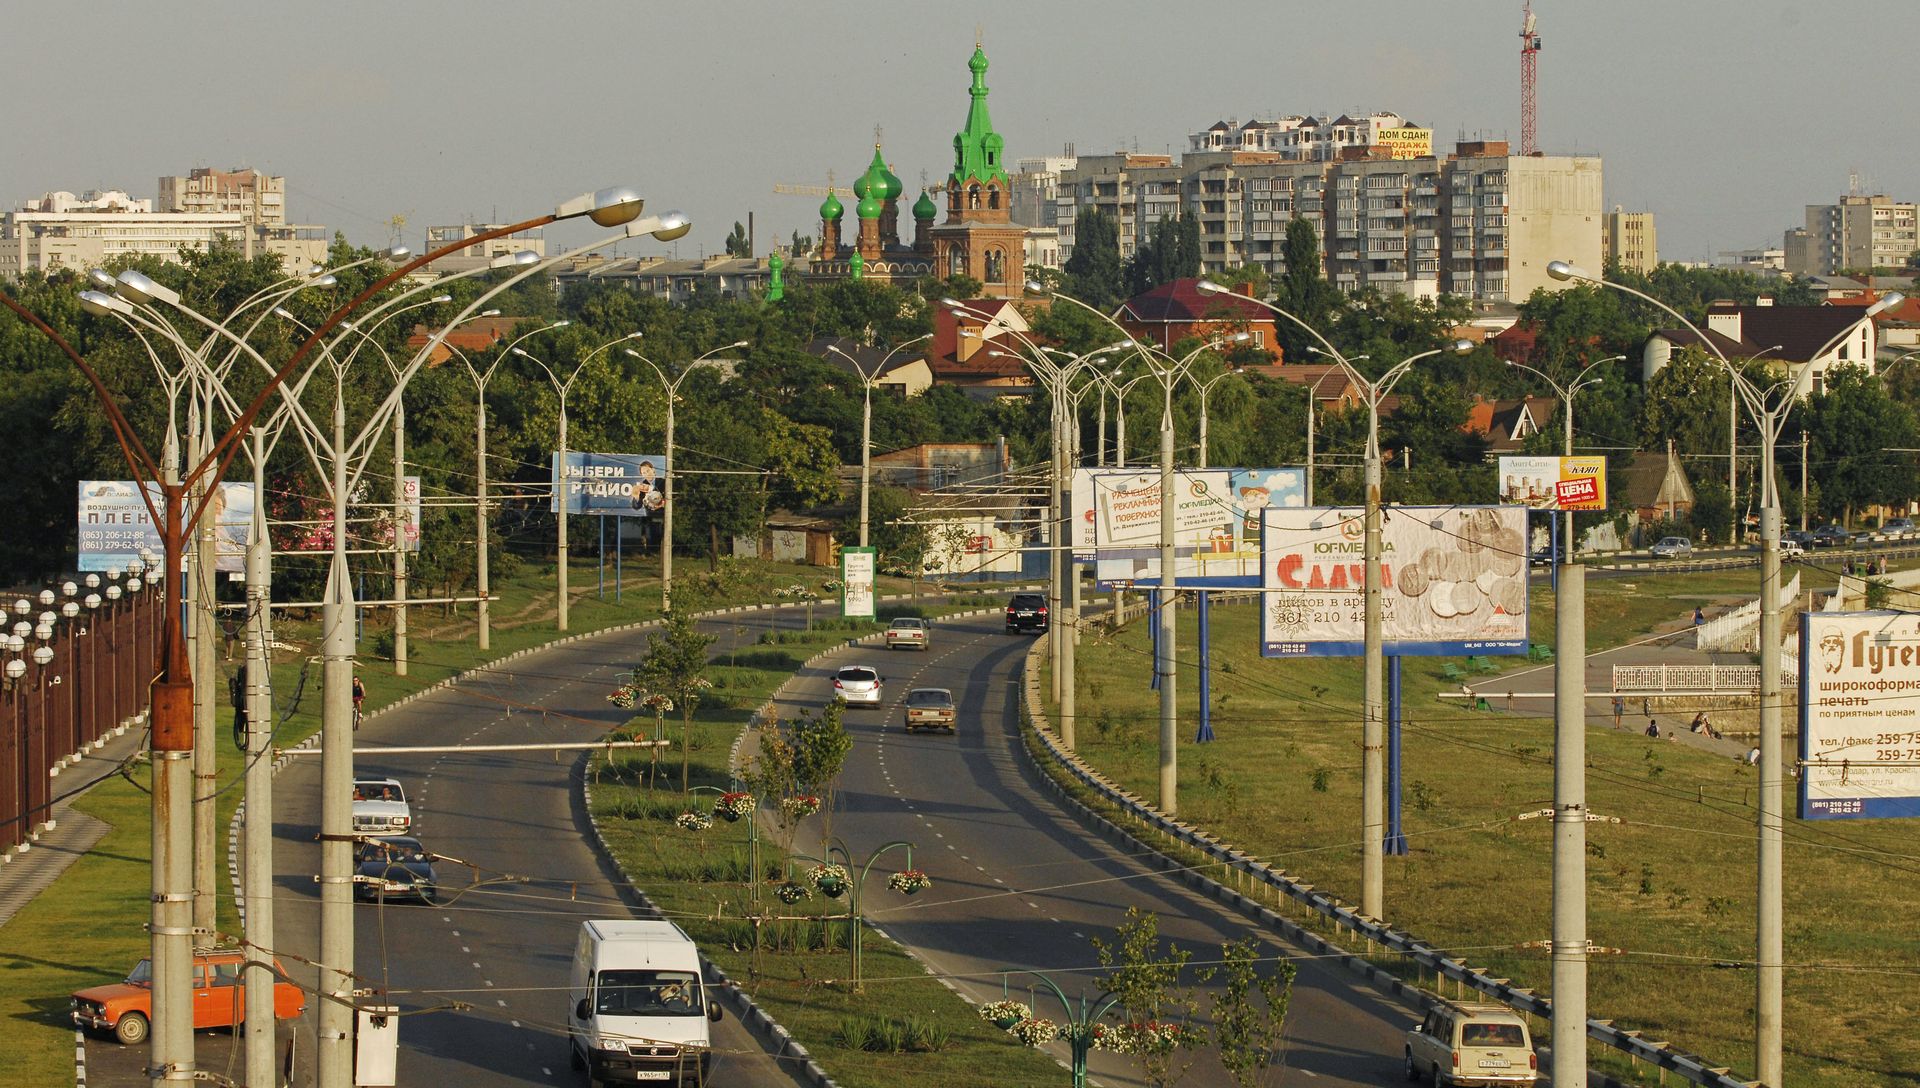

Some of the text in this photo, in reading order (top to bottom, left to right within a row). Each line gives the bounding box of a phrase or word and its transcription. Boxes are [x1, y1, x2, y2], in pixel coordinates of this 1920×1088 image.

[1379, 130, 1429, 140] ДОМ СДАН!
[1111, 485, 1161, 500] РАЗМЕЩЕНИ
[1560, 483, 1594, 498] ЦЕНА
[88, 512, 149, 524] ПЛЕН
[1115, 509, 1161, 523] ПОВЕРХНОС
[82, 530, 104, 540] (863)
[105, 530, 145, 539] 206-12-88
[82, 541, 104, 551] (861)
[1314, 542, 1396, 554] ЮГ-МЕА
[1314, 611, 1340, 622] 210
[1819, 696, 1869, 706] печать
[1833, 709, 1883, 719] приятным
[1884, 708, 1916, 717] ценам
